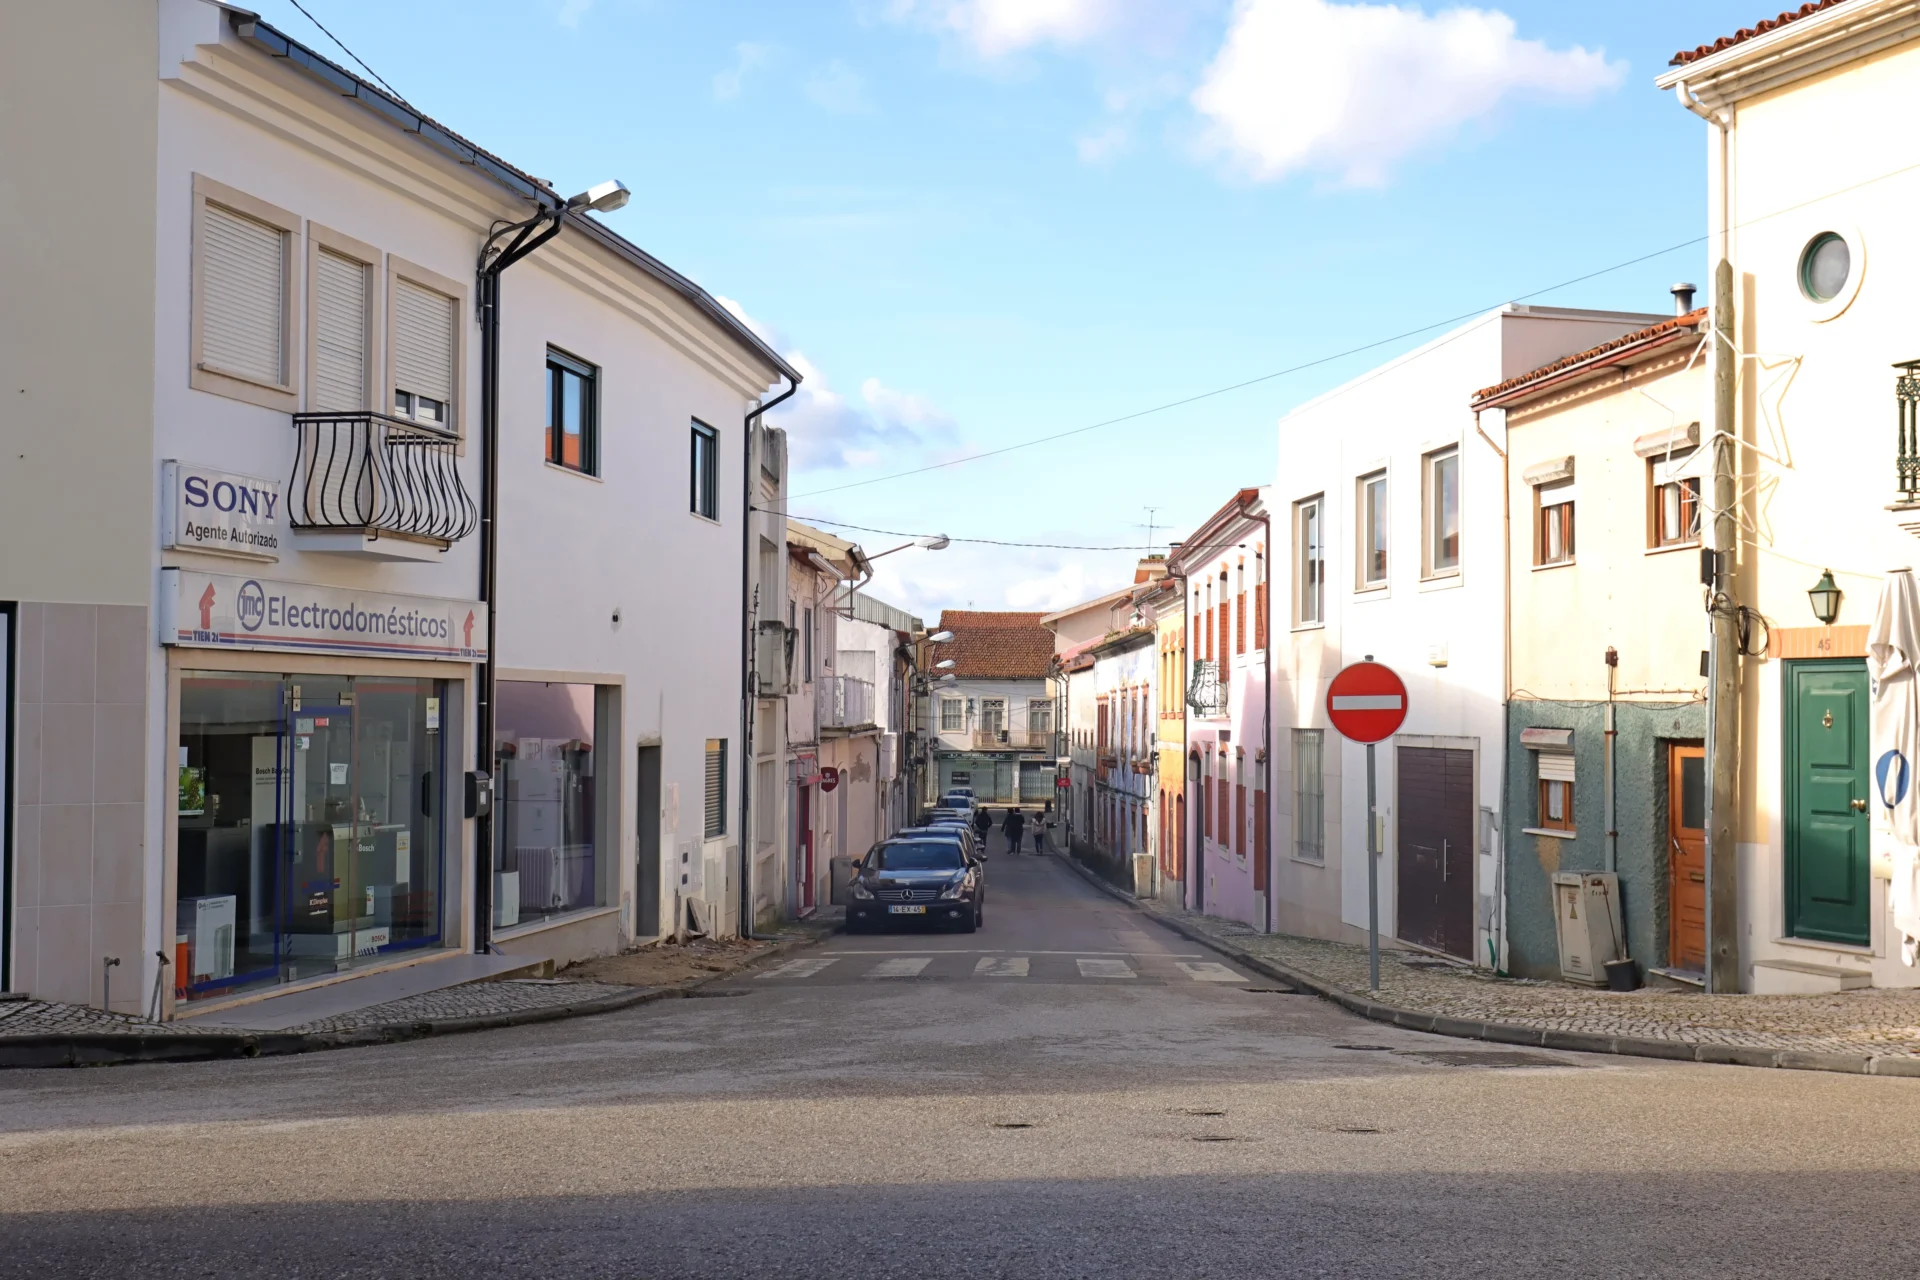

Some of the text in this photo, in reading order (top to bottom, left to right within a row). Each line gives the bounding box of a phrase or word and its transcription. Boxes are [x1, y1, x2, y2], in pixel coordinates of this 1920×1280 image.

[184, 476, 278, 519] SONY
[185, 521, 278, 549] Agente Autorizado
[240, 589, 447, 639] jmc Electrodomésticos
[193, 630, 211, 643] TIEN
[1817, 638, 1831, 651] 45
[460, 648, 472, 658] TIEN
[255, 767, 271, 775] Bosch
[358, 843, 375, 852] Bosch
[371, 934, 387, 943] BOSCH
